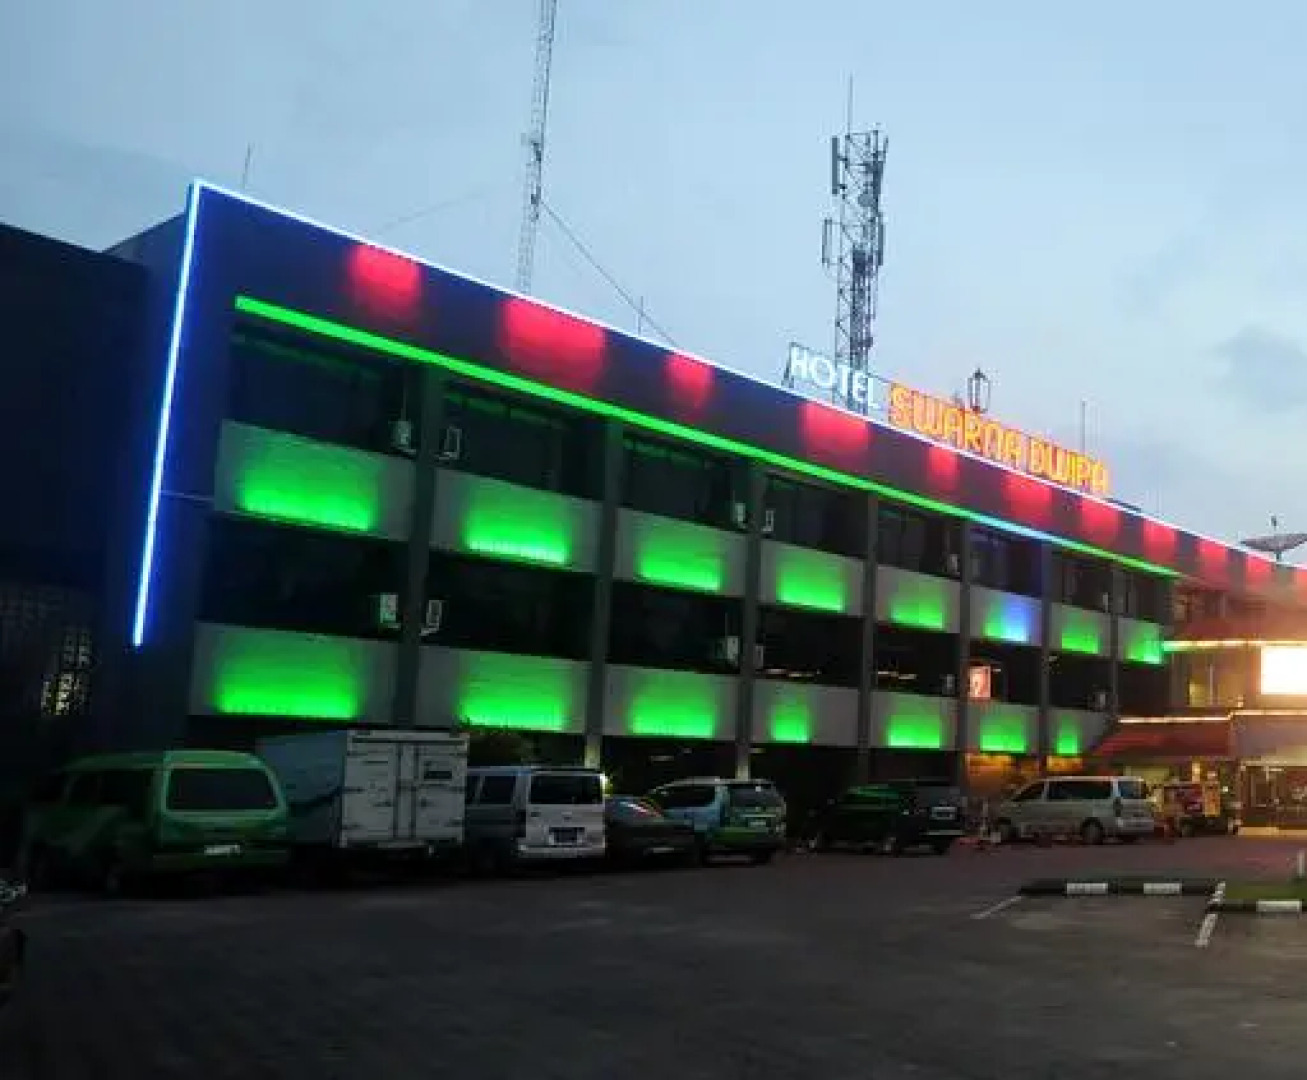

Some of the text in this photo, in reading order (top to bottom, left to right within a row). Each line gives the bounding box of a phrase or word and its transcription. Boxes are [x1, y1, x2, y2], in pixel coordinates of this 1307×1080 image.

[789, 344, 1109, 494] HOTEL SWARNA DWIPA
